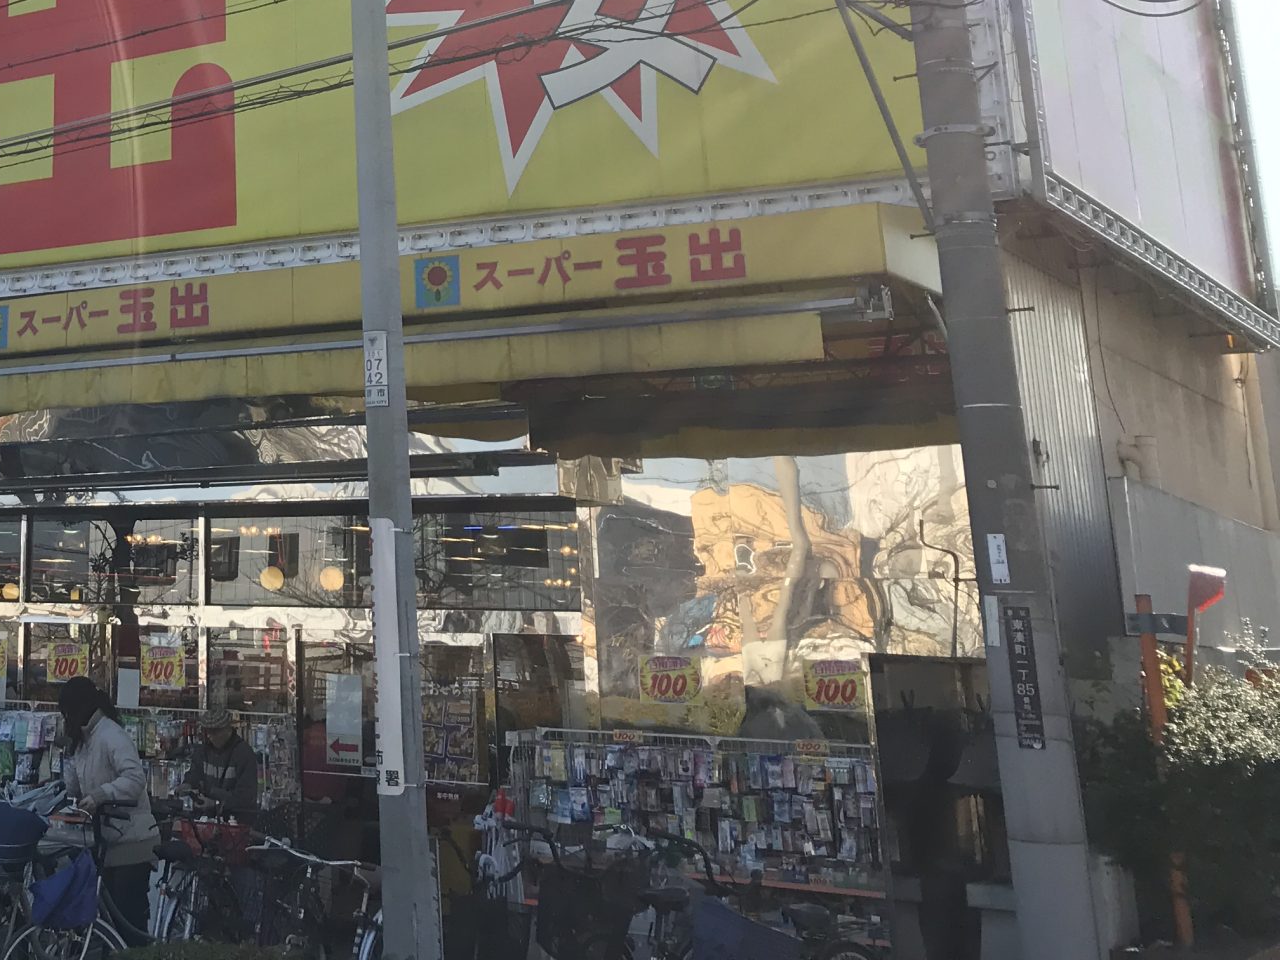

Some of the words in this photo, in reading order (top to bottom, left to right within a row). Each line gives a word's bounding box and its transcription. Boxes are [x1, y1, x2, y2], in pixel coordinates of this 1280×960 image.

[53, 657, 79, 677] 100
[145, 660, 174, 681] 100
[648, 672, 688, 697] 100
[815, 678, 858, 704] 100
